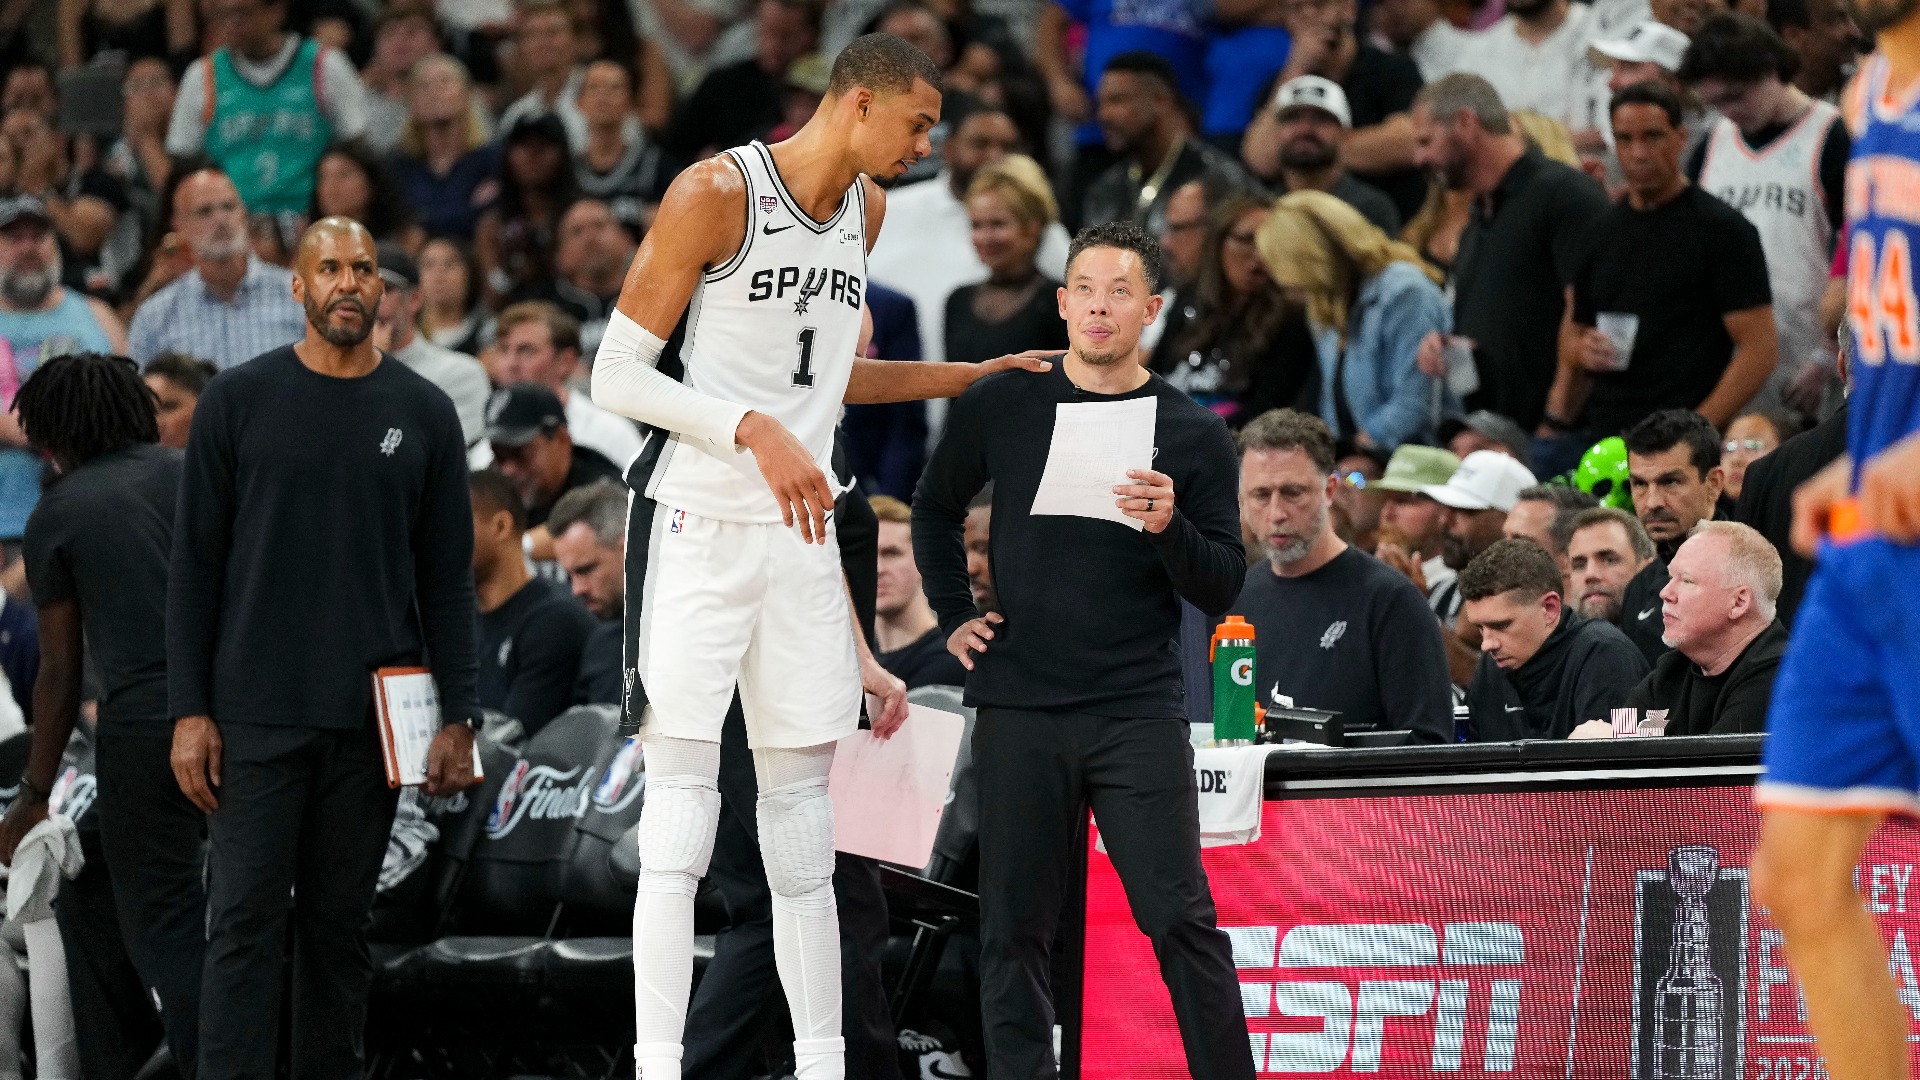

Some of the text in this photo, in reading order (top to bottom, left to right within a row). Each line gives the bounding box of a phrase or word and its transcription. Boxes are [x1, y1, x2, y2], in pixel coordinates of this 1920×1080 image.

[748, 265, 862, 317] SPURS
[1848, 228, 1920, 366] 44
[791, 326, 818, 390] 1
[1230, 657, 1253, 686] G
[486, 763, 596, 839] Finals
